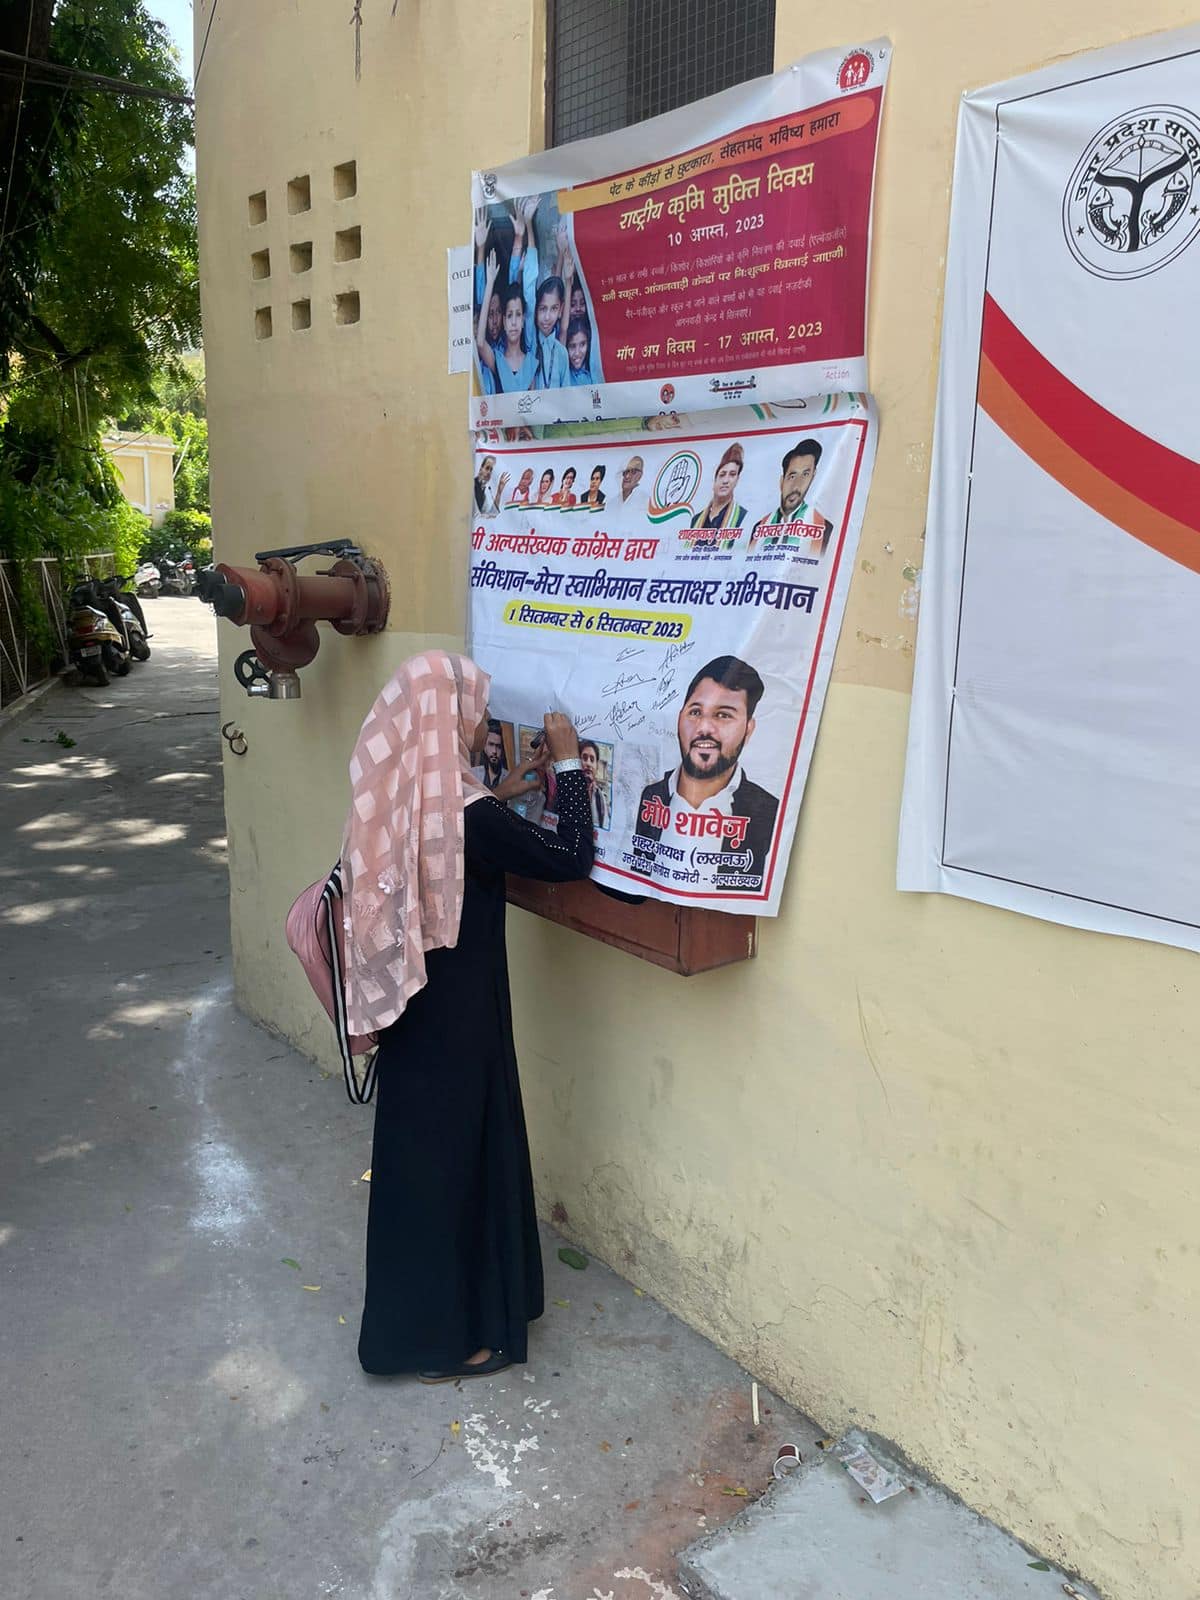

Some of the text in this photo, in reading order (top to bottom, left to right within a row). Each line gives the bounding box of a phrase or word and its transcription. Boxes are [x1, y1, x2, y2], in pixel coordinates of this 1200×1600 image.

[609, 183, 621, 196] पेट
[626, 178, 635, 192] के
[664, 166, 674, 182] से
[720, 134, 763, 160] सेहतमंद
[769, 124, 804, 145] भविष्य
[810, 112, 840, 136] हमारा
[1075, 151, 1104, 201] उत्तर
[1103, 118, 1160, 151] प्रदेश
[619, 163, 815, 231] राष्ट्रीय कृमि मुक्ति दिवस
[667, 214, 764, 247] 10 अगस्त, 2023
[718, 272, 731, 281] पर
[616, 344, 636, 361] मॉप
[641, 344, 660, 358] अप
[666, 337, 696, 356] दिवस
[718, 335, 732, 349] 17
[741, 328, 779, 347] अगस्त,
[788, 321, 823, 340] 2023
[486, 528, 570, 555] अल्पसंख्यक
[572, 530, 624, 560] कांग्रेस
[624, 538, 660, 562] द्वारा
[716, 528, 744, 540] आलम
[784, 519, 825, 540] मलिक
[565, 568, 646, 602] स्वाभिमान
[647, 578, 721, 606] हस्ताक्षर
[721, 571, 818, 614] अभियान
[509, 604, 684, 638] 1 सितम्बर से 6 सितम्बर 2023
[632, 834, 754, 872] शहर अध्यक्ष (लखनऊ)
[672, 867, 700, 884] कमेटी
[710, 872, 762, 888] अल्पसंख्यक
